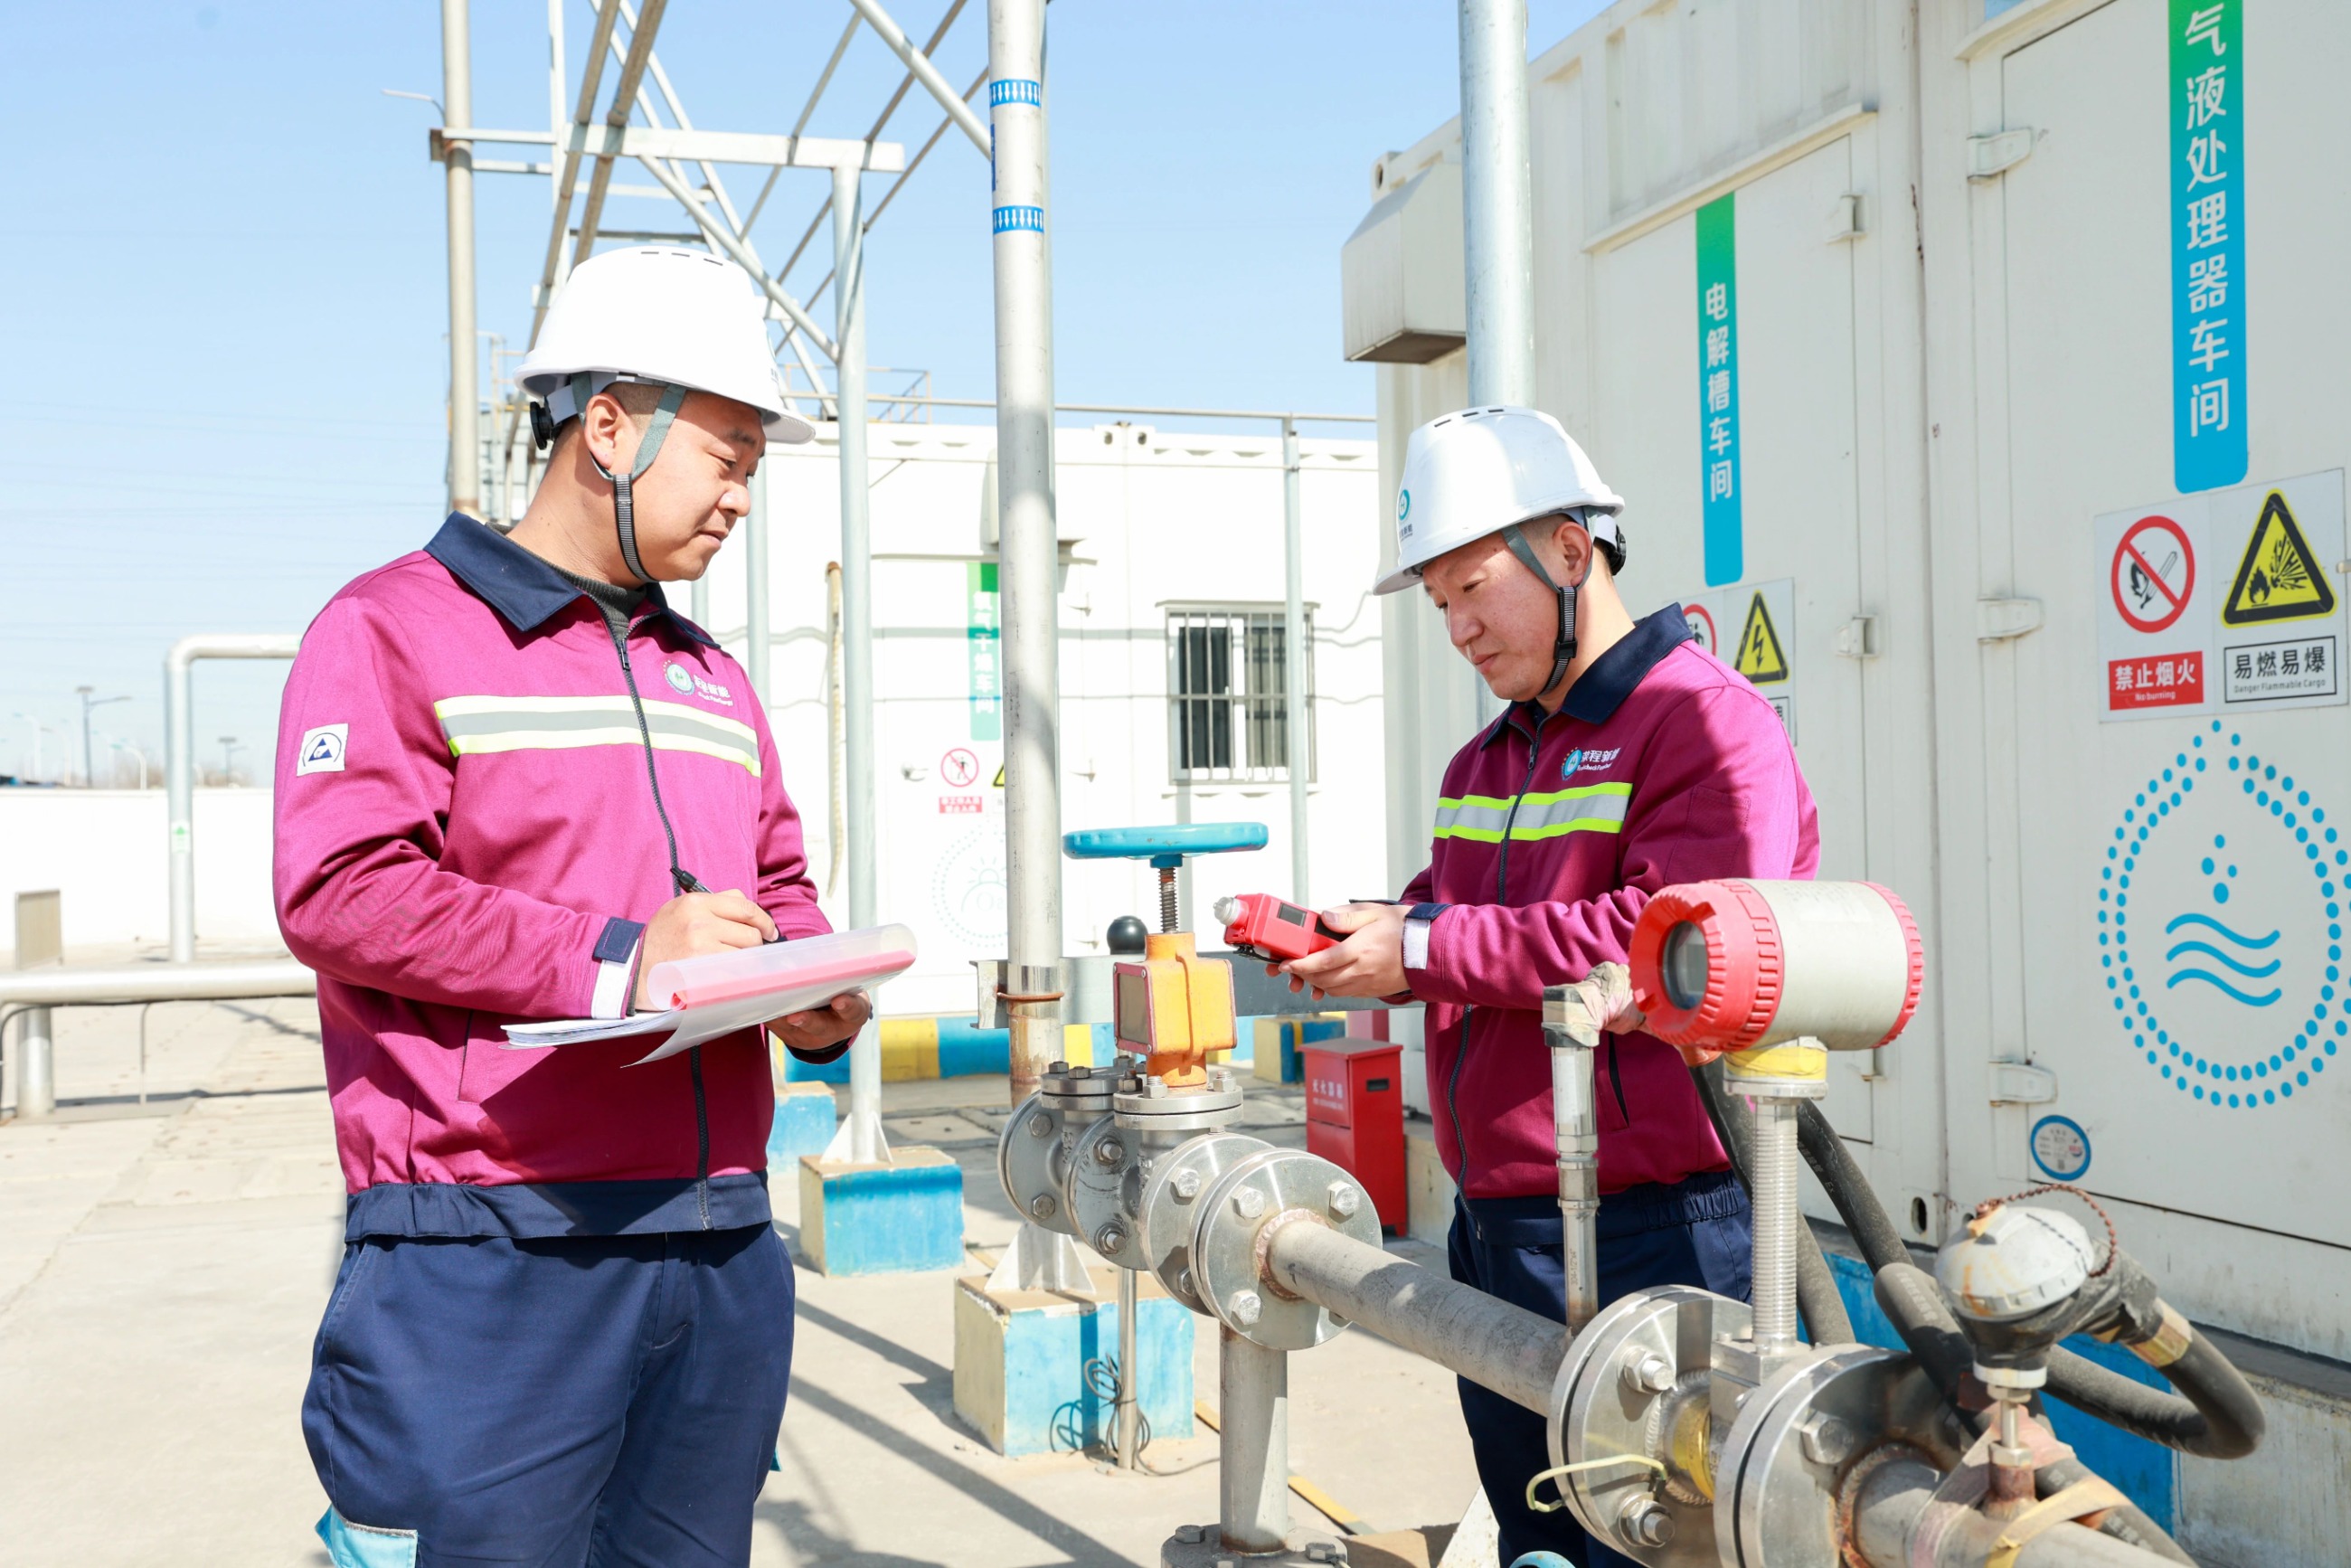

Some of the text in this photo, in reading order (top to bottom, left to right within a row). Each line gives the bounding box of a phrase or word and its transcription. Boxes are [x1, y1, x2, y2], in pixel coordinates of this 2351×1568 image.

[2185, 3, 2230, 438] 气液处理器车间
[1705, 282, 1733, 503] 电解槽车间
[2115, 658, 2196, 691] 禁止烟火
[2234, 647, 2326, 679] 易燃易爆
[2303, 678, 2327, 688] Cargo
